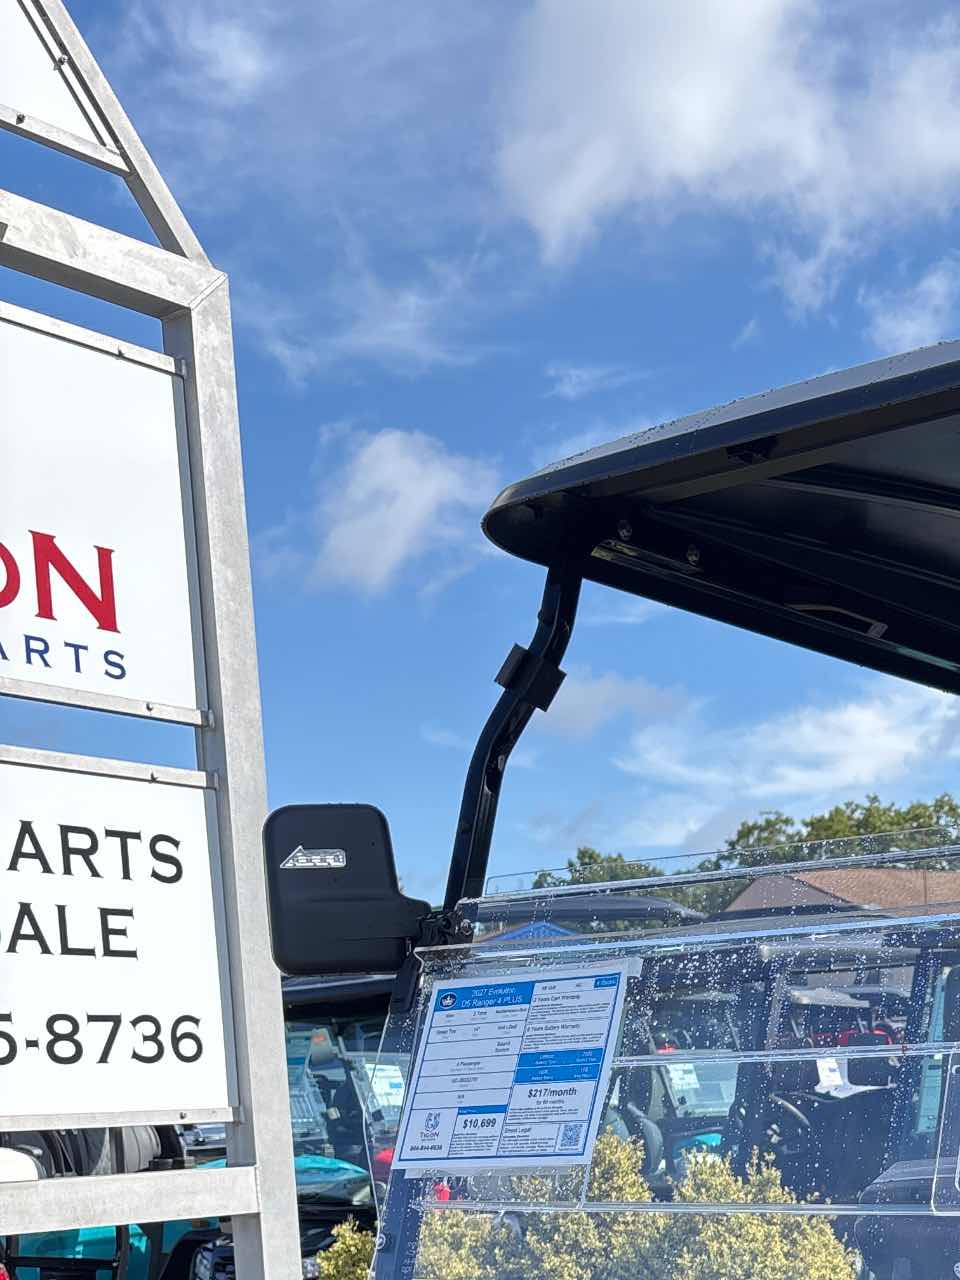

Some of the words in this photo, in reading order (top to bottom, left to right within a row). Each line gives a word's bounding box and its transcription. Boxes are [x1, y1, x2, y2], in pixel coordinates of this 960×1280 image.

[0, 529, 121, 634] N
[0, 901, 139, 960] ALE
[527, 1087, 577, 1099] $217/month
[463, 1117, 497, 1130] $10,699
